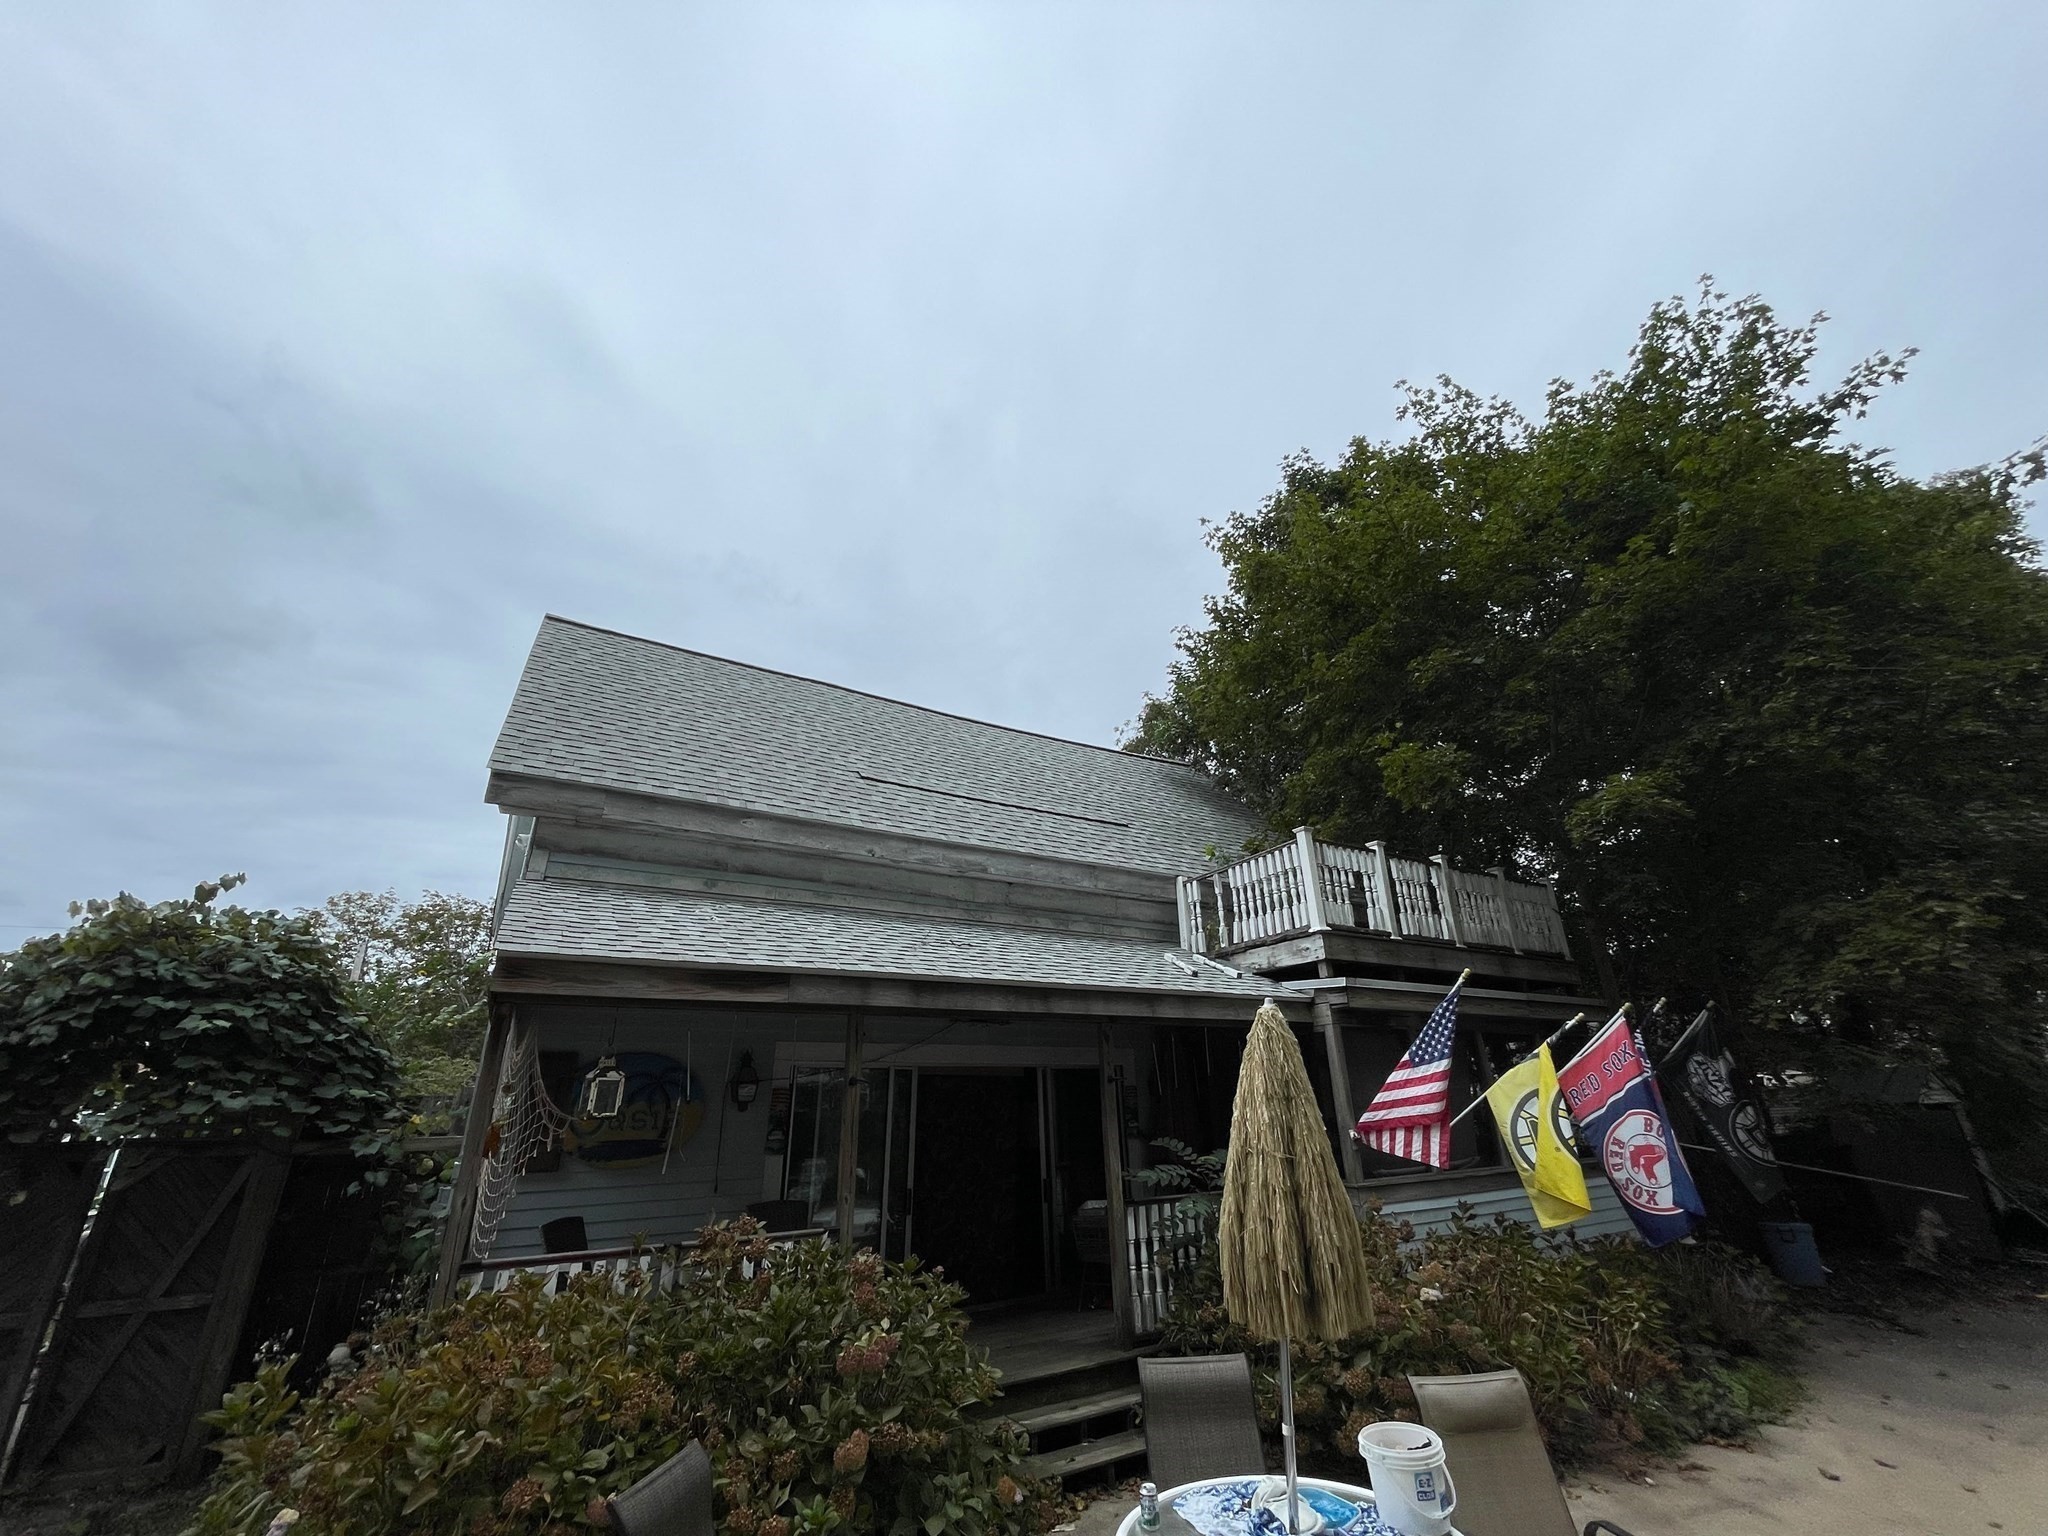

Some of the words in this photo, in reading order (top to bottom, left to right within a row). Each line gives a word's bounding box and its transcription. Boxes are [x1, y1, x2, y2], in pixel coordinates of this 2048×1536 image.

[1568, 1072, 1601, 1108] RED
[1601, 1040, 1636, 1080] SOX
[1609, 1136, 1625, 1172] RED
[1621, 1177, 1659, 1206] SOX
